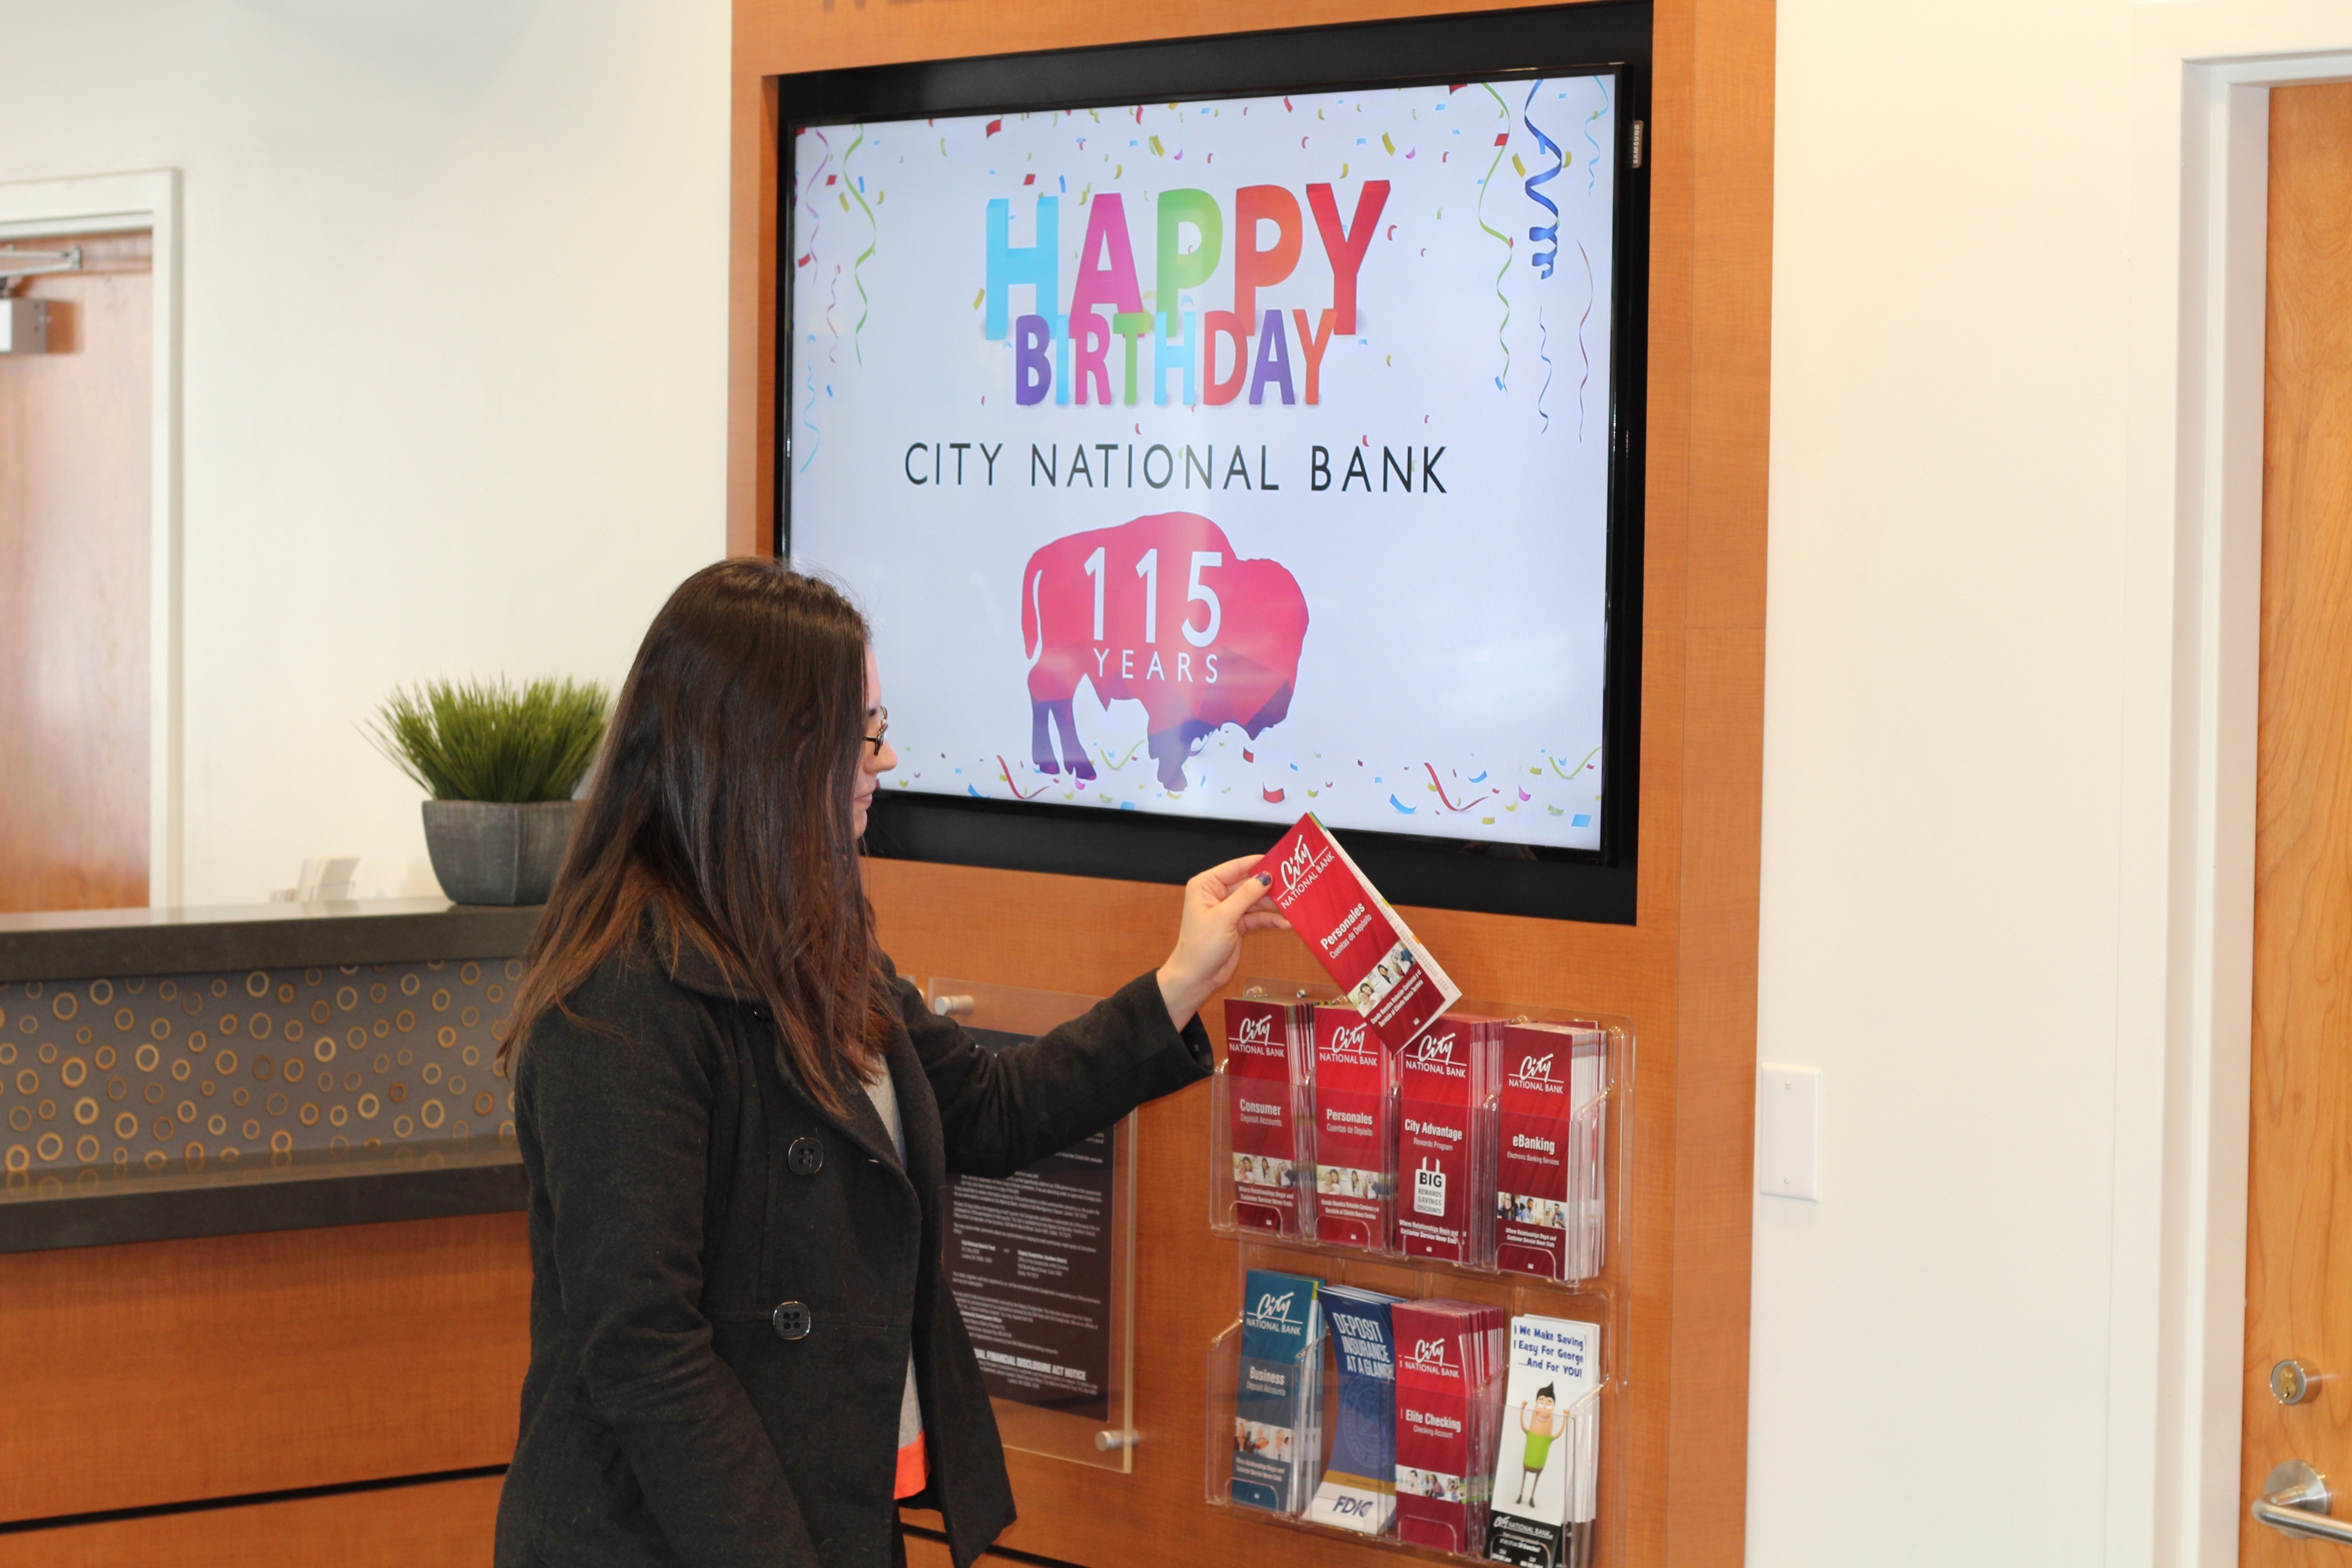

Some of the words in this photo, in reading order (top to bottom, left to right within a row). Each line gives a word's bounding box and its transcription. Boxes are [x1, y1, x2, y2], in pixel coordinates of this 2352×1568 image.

[986, 180, 1391, 340] HAPPY
[1016, 309, 1339, 406] BIRTHDAY
[905, 443, 1003, 485] CITY
[1032, 444, 1279, 491] NATIONAL
[1311, 445, 1447, 494] BANK
[1083, 546, 1222, 648] 115
[1093, 648, 1218, 684] YEARS
[1281, 834, 1315, 890] City
[1281, 872, 1318, 909] NATIONAL
[1316, 852, 1334, 873] BANK
[1320, 903, 1365, 950] Personales
[1330, 938, 1349, 959] Cuentas
[1240, 1014, 1272, 1046] City
[1332, 1022, 1367, 1054] City
[1229, 1044, 1265, 1055] NATIONAL
[1266, 1047, 1284, 1058] BANK
[1319, 1053, 1358, 1064] NATIONAL
[1359, 1057, 1377, 1066] BANK
[1418, 1033, 1456, 1065] City
[1406, 1060, 1444, 1075] NATIONAL
[1446, 1066, 1465, 1078] BANK
[1520, 1053, 1554, 1083] City
[1509, 1079, 1544, 1091] NATIONAL
[1545, 1083, 1563, 1094] BANK
[1240, 1098, 1281, 1116] Consumer
[1327, 1109, 1372, 1125] Personales
[1240, 1113, 1258, 1123] Deposit
[1260, 1116, 1282, 1127] Accounts
[1327, 1123, 1346, 1132] Cuentas
[1405, 1119, 1420, 1134] City
[1422, 1122, 1462, 1142] Advantage
[1414, 1138, 1433, 1148] Rewards
[1434, 1141, 1453, 1152] Program
[1513, 1134, 1555, 1155] eBanking
[1508, 1152, 1526, 1160] Electronic
[1526, 1154, 1542, 1164] Banking
[1543, 1156, 1559, 1166] Services
[1420, 1172, 1442, 1188] BIG
[1418, 1189, 1442, 1198] REWARDS
[1418, 1196, 1442, 1207] SAVINGS
[1417, 1204, 1441, 1214] DISCOUNTS
[1258, 1292, 1294, 1323] City
[1246, 1319, 1279, 1332] NATIONAL
[1282, 1325, 1301, 1335] BANK
[1332, 1312, 1383, 1343] DEPOSIT
[1341, 1335, 1390, 1363] INSURANCE
[1519, 1325, 1530, 1335] We
[1534, 1329, 1554, 1341] Make
[1557, 1334, 1583, 1352] Saving
[1415, 1338, 1444, 1367] City
[1519, 1341, 1538, 1356] Easy
[1541, 1345, 1554, 1356] For
[1558, 1348, 1583, 1366] George
[1347, 1355, 1356, 1373] AT
[1358, 1358, 1364, 1374] A
[1405, 1361, 1439, 1375] NATIONAL
[1441, 1368, 1459, 1378] BANK
[1546, 1362, 1559, 1372] For
[1249, 1366, 1285, 1385] Business
[1406, 1410, 1423, 1423] Elite
[1425, 1413, 1461, 1432] Checking
[1414, 1425, 1434, 1436] Checking
[1435, 1429, 1453, 1439] Account
[1333, 1495, 1374, 1517] FDIC
[1508, 1522, 1534, 1535] NATIONAL
